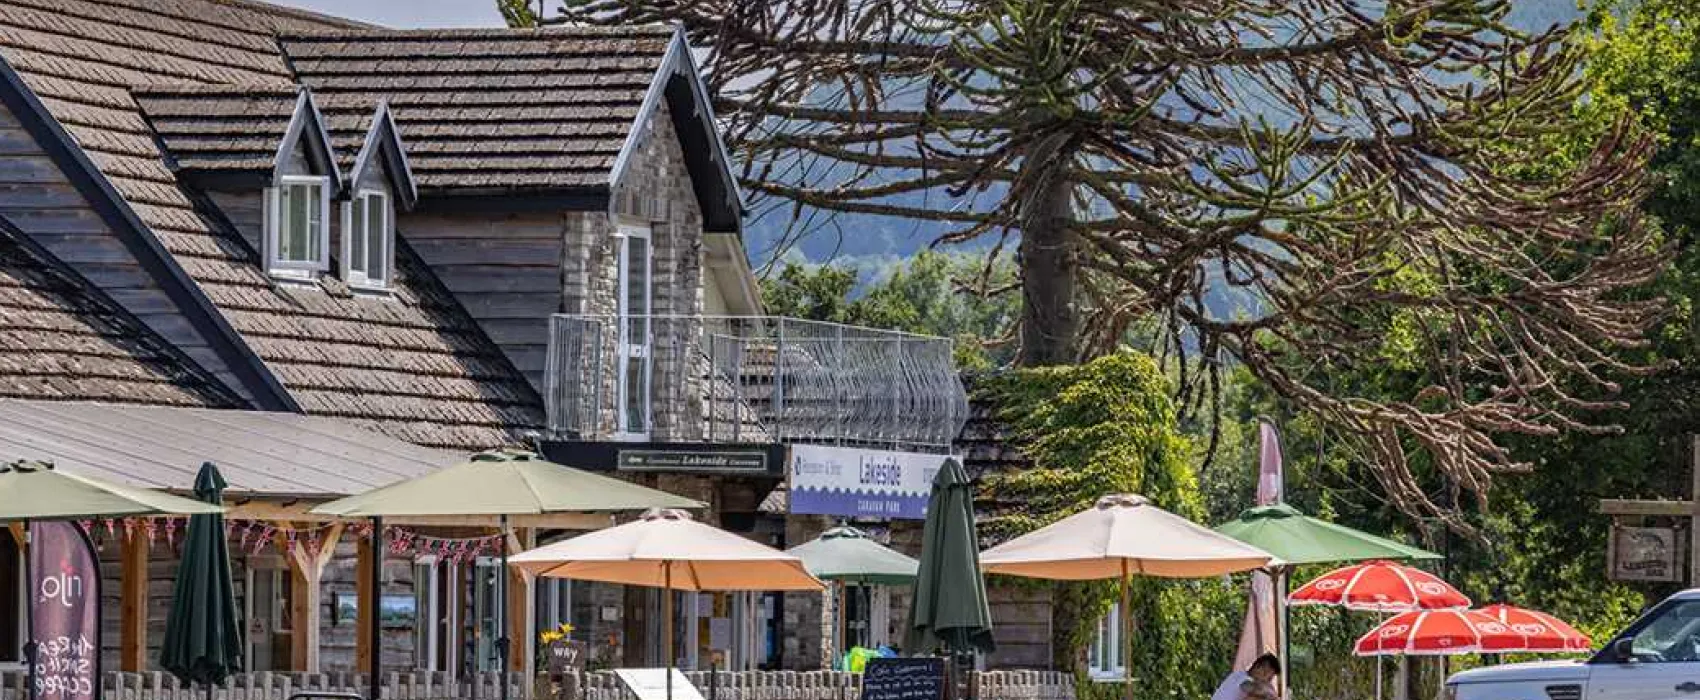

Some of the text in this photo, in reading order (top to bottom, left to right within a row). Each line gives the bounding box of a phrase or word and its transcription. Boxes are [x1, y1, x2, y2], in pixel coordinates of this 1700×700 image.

[682, 454, 728, 466] Lakeside
[859, 454, 901, 487] Lakeside
[885, 500, 900, 514] PARK
